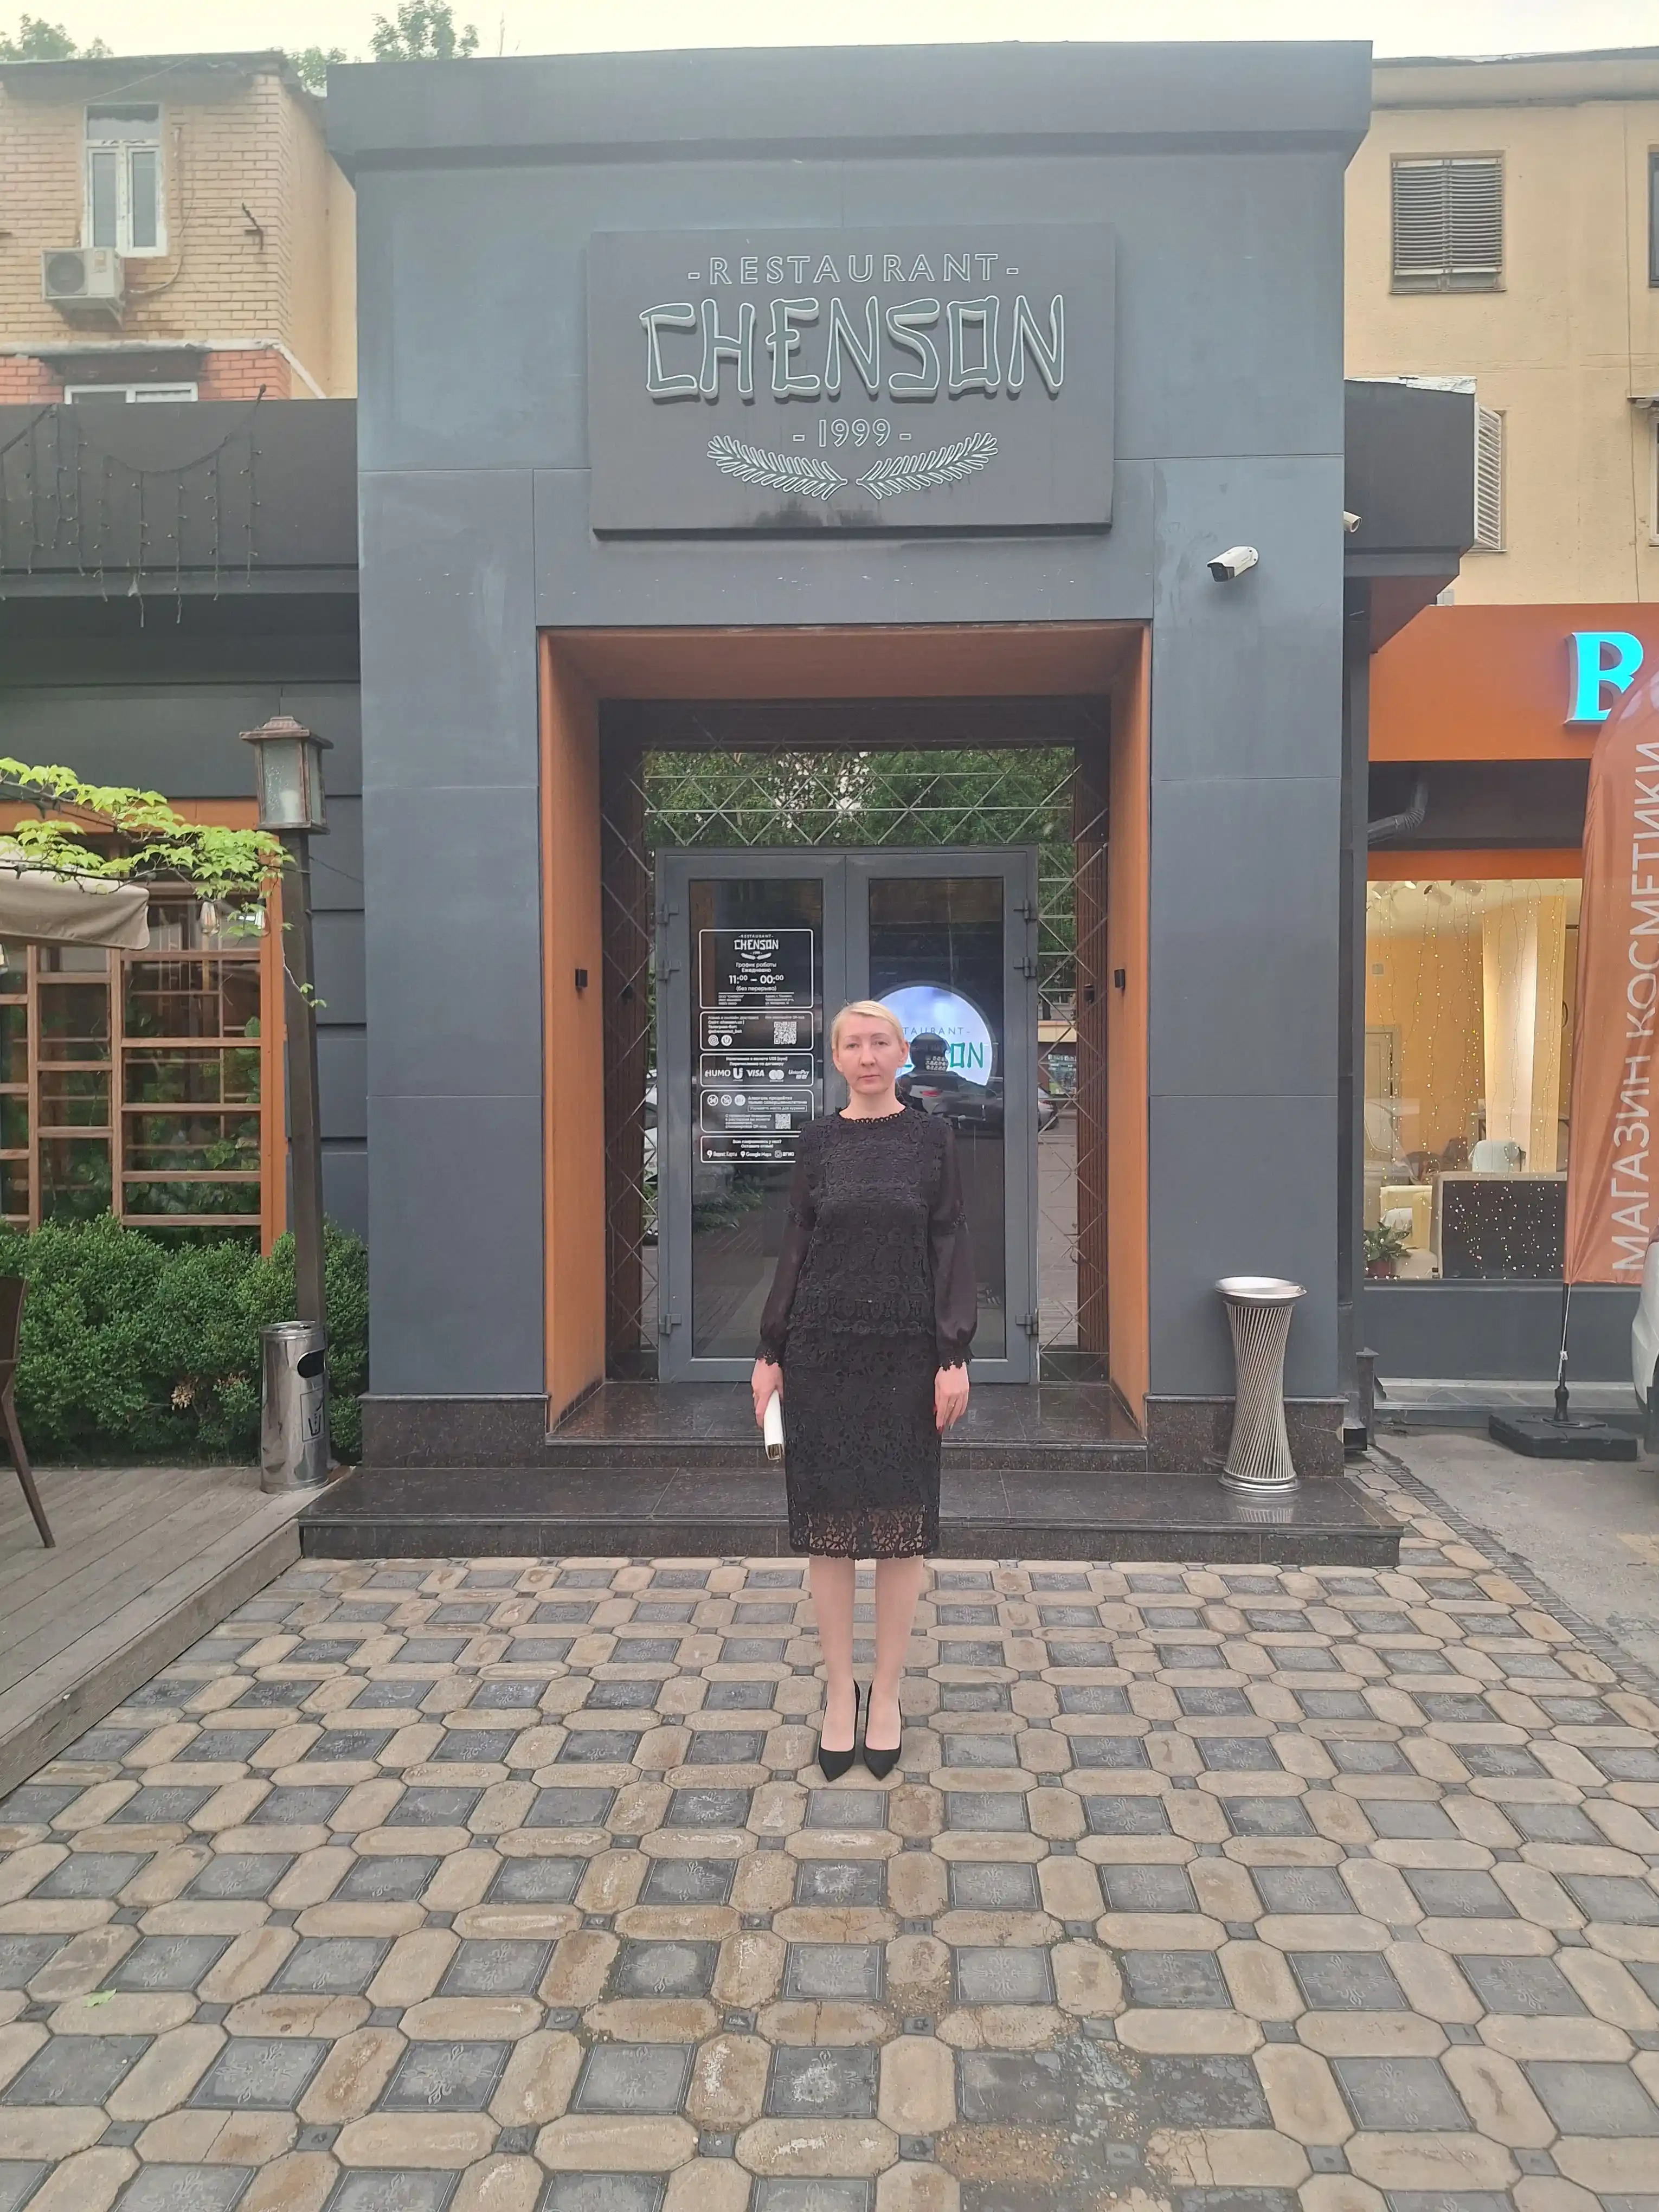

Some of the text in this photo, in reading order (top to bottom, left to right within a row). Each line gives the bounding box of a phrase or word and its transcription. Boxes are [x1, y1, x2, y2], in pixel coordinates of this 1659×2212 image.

[639, 294, 1065, 398] CHENSON
[734, 939, 779, 950] CHENSON
[1611, 742, 1659, 1270] МАГАЗИН КОСМЕТИКИ
